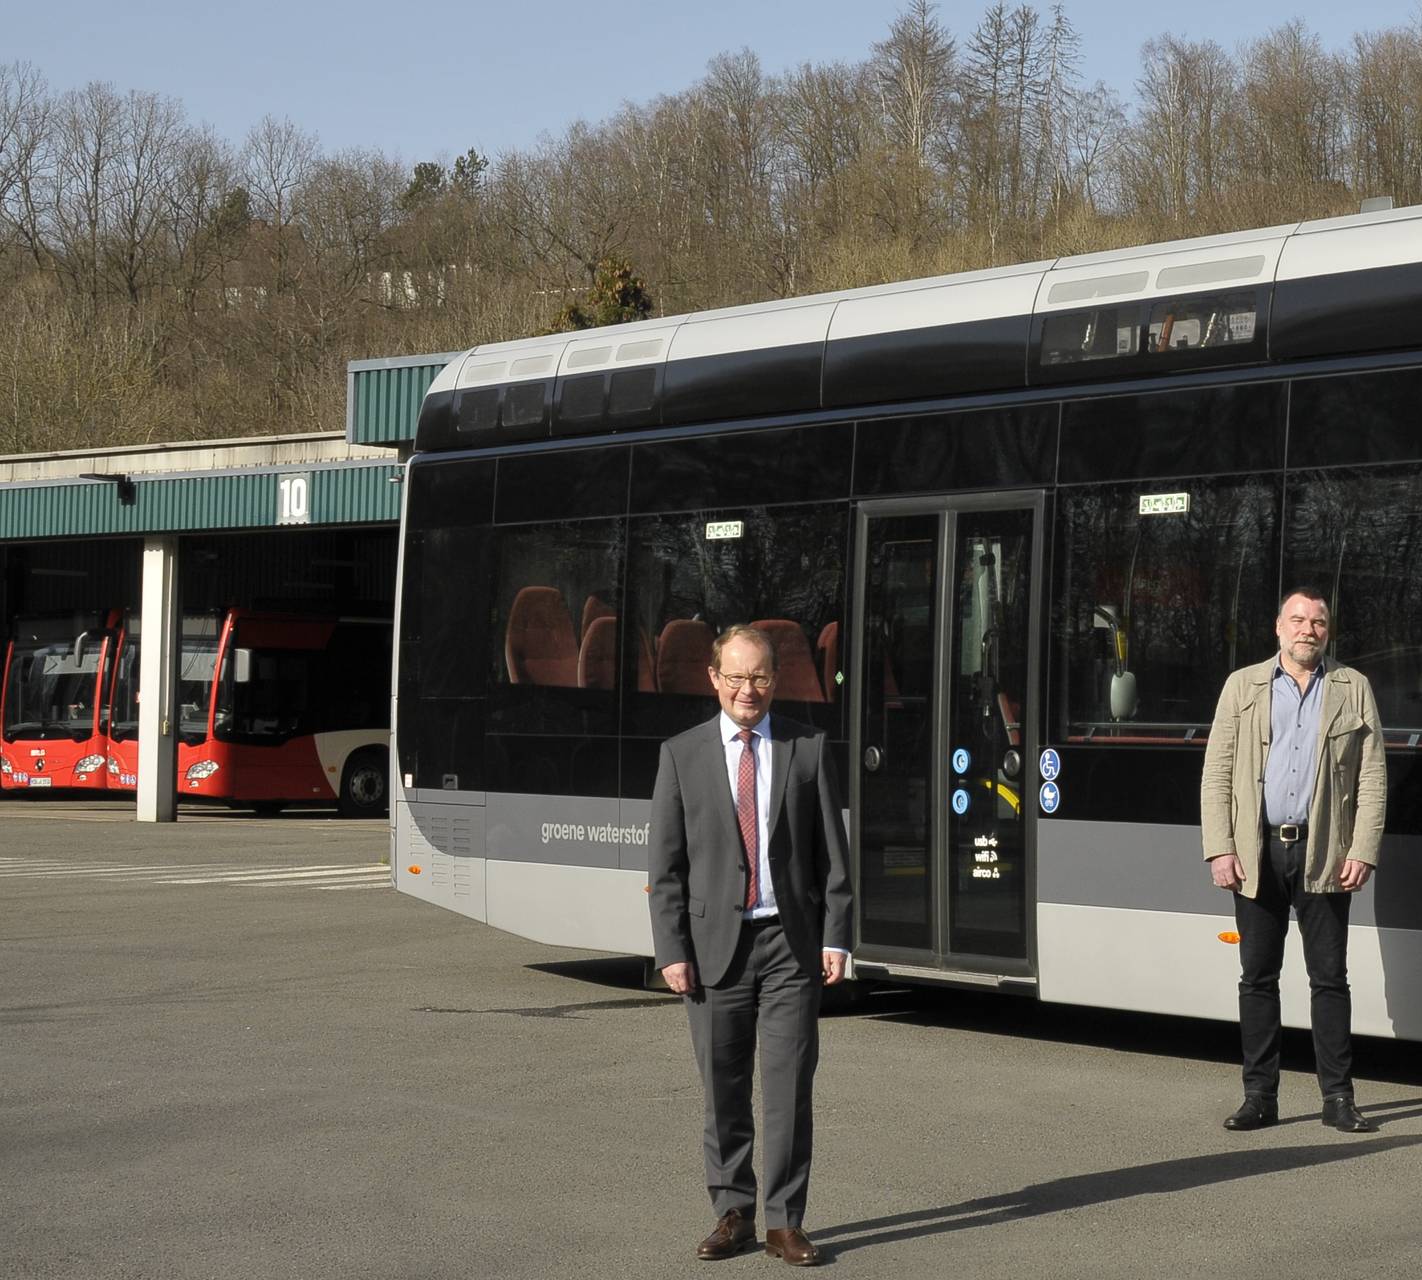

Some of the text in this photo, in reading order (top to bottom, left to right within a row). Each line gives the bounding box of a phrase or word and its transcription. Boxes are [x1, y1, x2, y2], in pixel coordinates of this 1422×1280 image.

[280, 478, 307, 517] 10
[541, 822, 650, 845] groene waterstof
[974, 834, 988, 847] usb
[974, 850, 990, 862] wifi
[972, 866, 992, 878] airco
